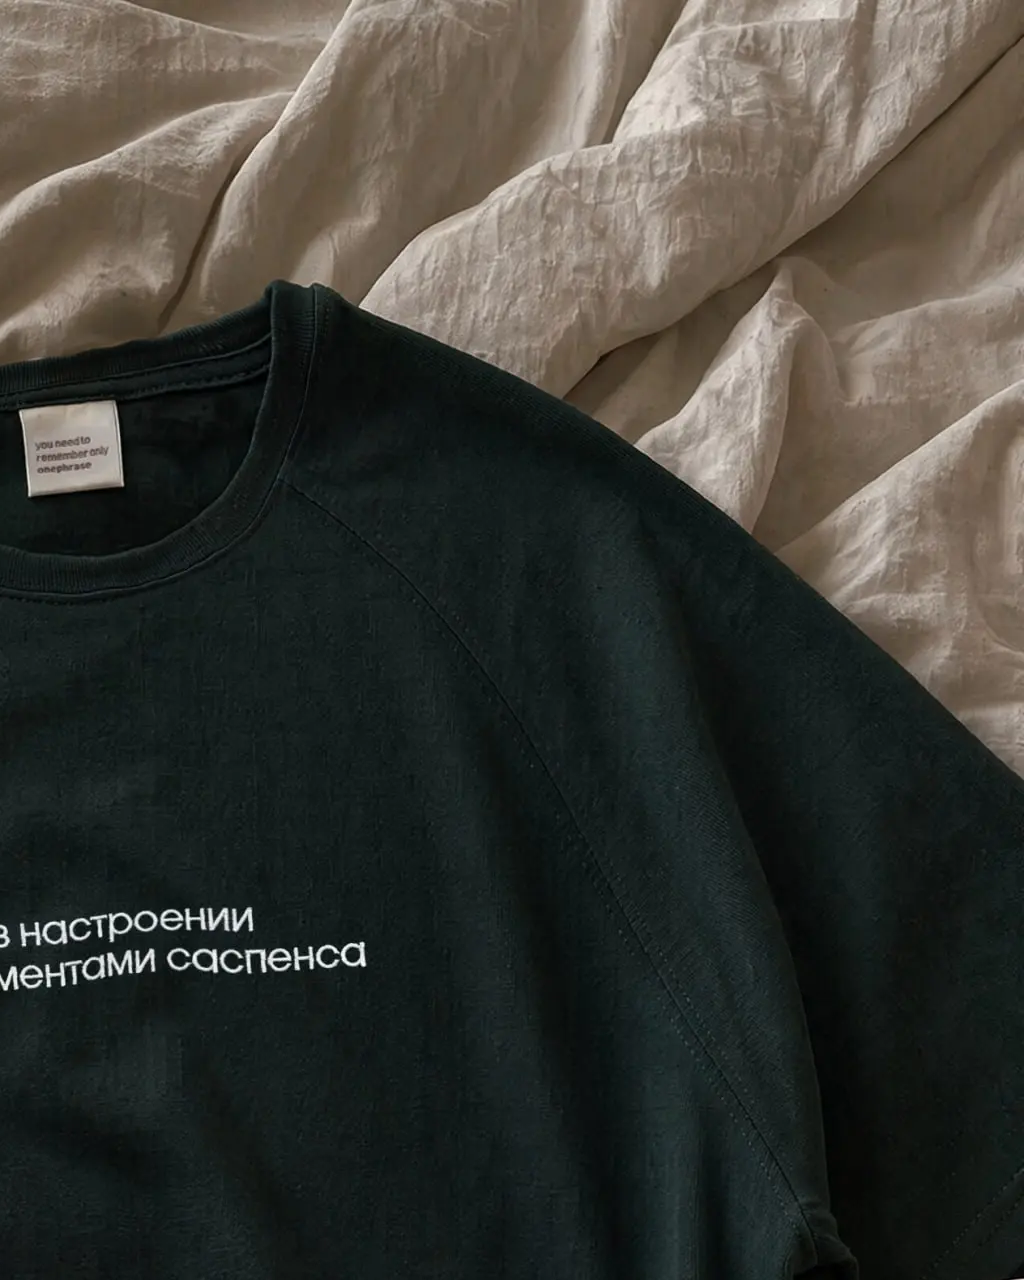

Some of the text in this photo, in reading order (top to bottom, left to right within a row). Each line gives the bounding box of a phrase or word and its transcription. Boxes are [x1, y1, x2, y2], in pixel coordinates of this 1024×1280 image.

[35, 436, 91, 451] you need to
[36, 446, 109, 462] remember only
[19, 907, 254, 947] настроении
[166, 941, 367, 975] саспенса
